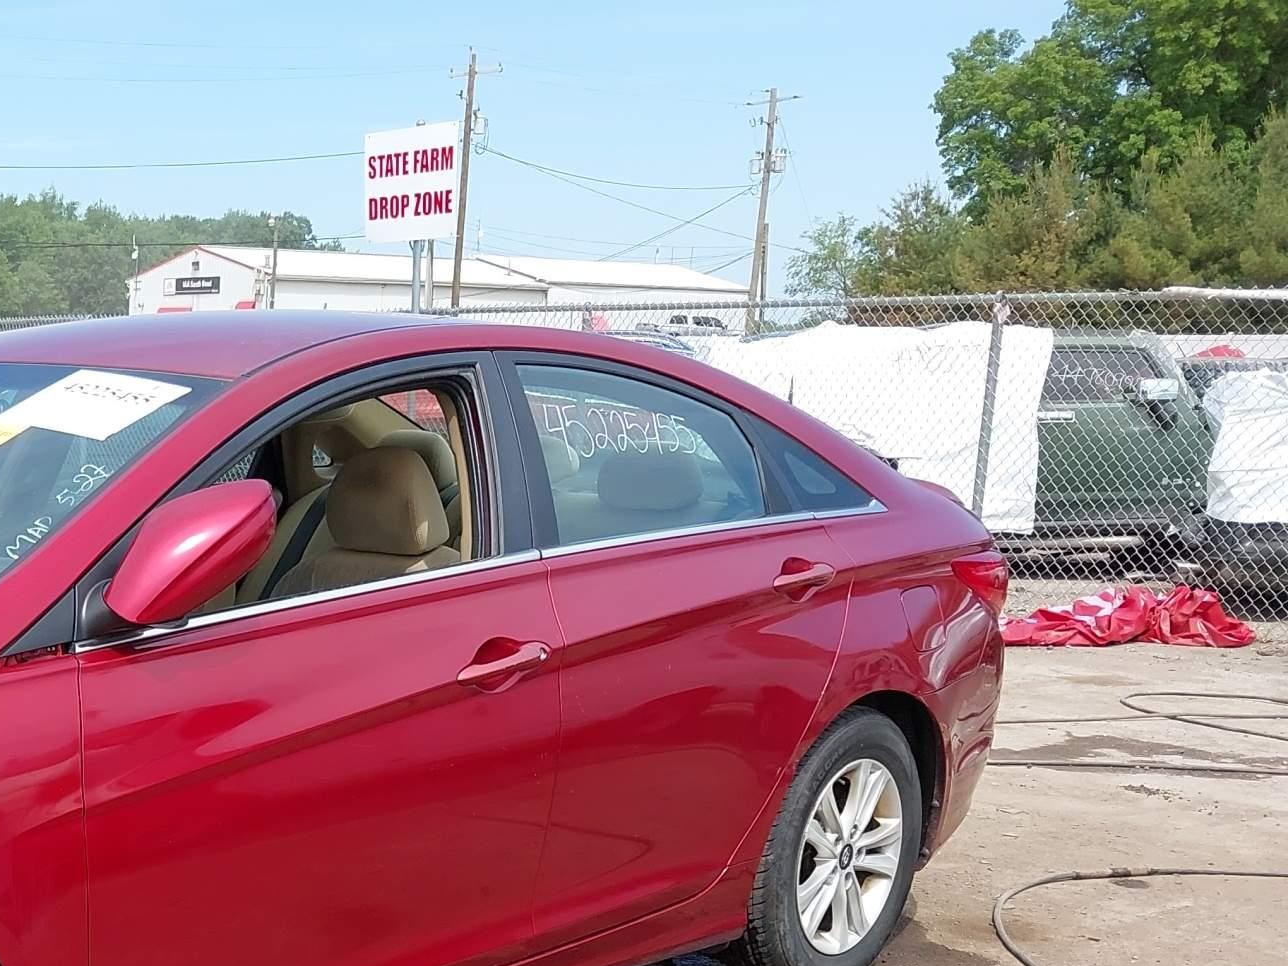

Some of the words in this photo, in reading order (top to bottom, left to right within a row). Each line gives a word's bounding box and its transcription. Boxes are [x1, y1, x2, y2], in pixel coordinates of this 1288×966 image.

[368, 152, 409, 179] STATE
[413, 146, 454, 174] FARM
[368, 194, 410, 221] DROP
[413, 189, 453, 217] ZONE
[542, 403, 697, 461] 45225455
[6, 516, 52, 560] MAD
